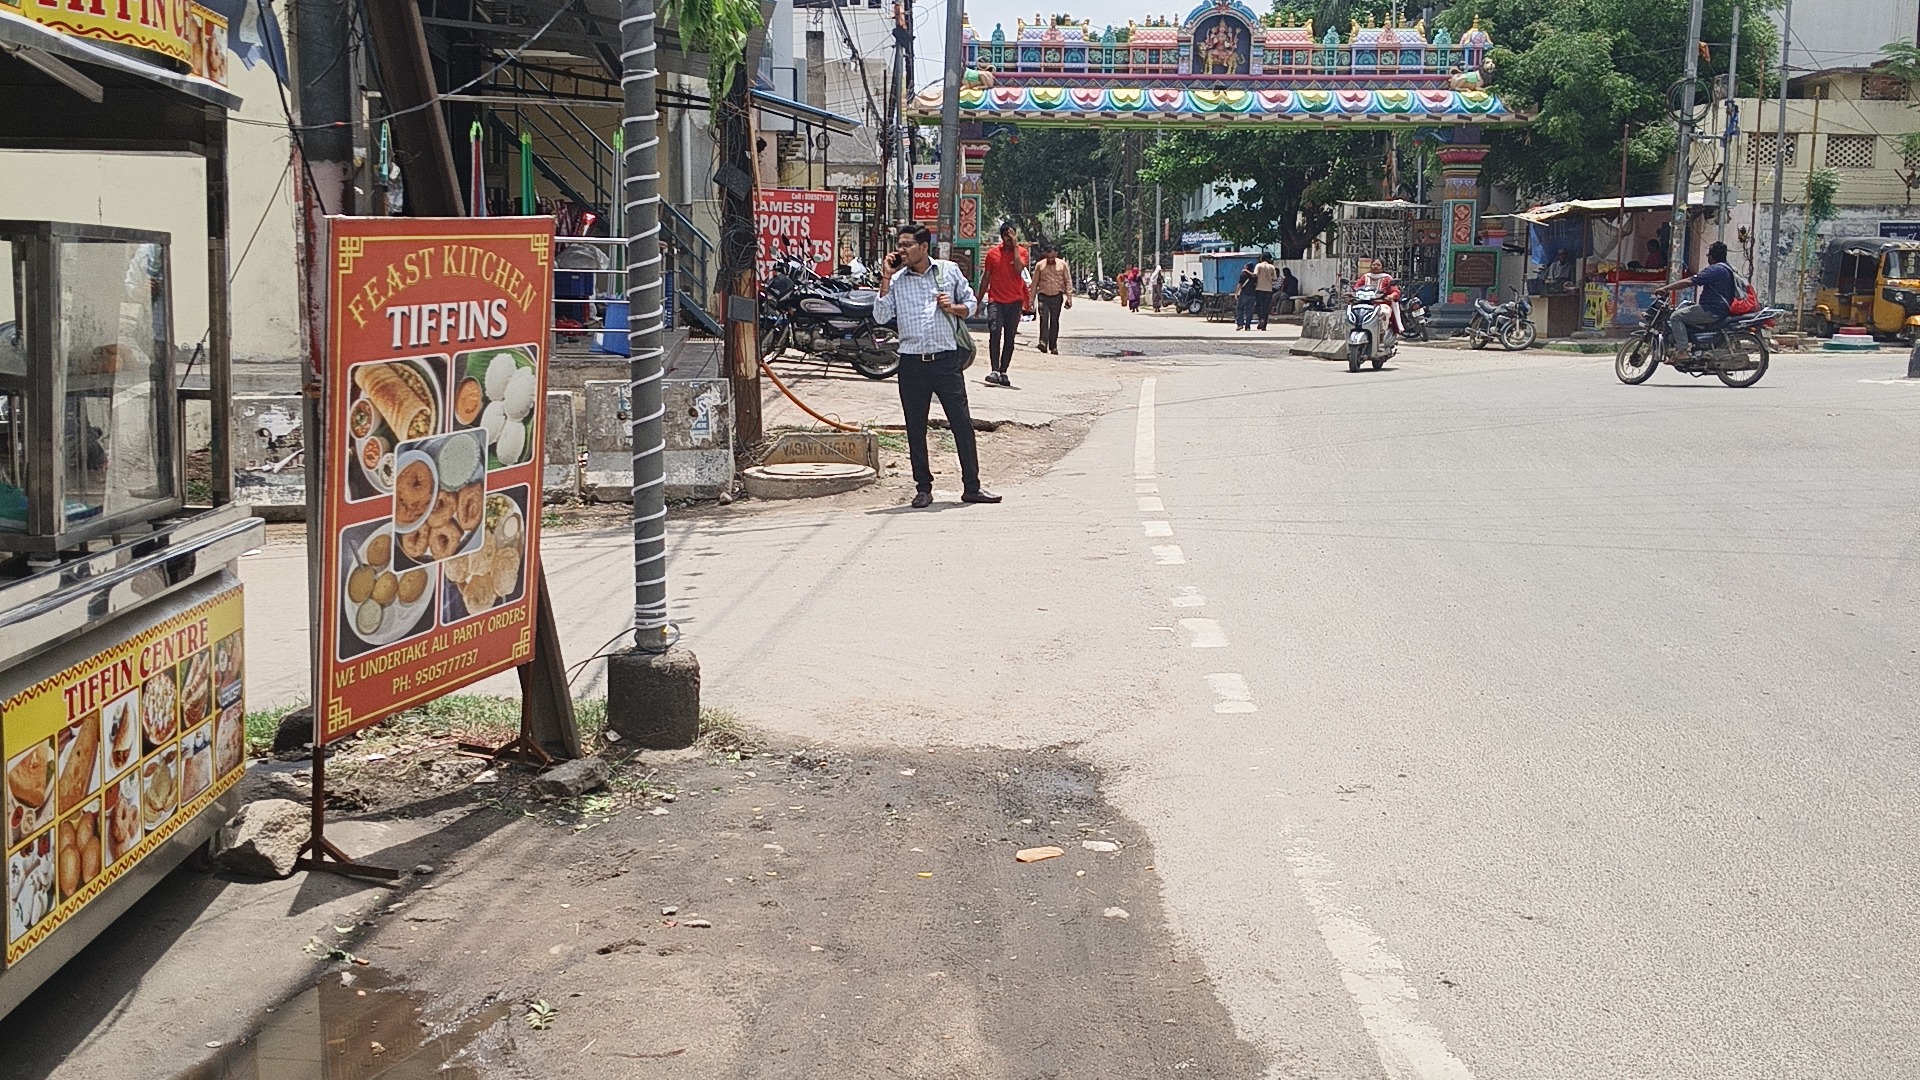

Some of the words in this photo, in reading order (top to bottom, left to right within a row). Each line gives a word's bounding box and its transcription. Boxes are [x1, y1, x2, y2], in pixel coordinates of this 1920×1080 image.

[915, 172, 940, 180] BES
[348, 247, 435, 329] FEAST
[443, 245, 537, 314] KITCHEN
[385, 298, 509, 349] TIFFINS
[782, 442, 817, 456] VASAVI
[820, 442, 856, 456] NAGAR
[64, 654, 134, 722] TIFFIN
[139, 617, 209, 679] CENTRE
[335, 665, 356, 689] WE
[360, 639, 428, 680] UNDERTAKE
[431, 634, 449, 654] ALL
[453, 619, 485, 646] PARTY
[487, 605, 526, 633] ORDERS
[392, 674, 412, 695] PH:
[415, 648, 479, 686] 9505777737
